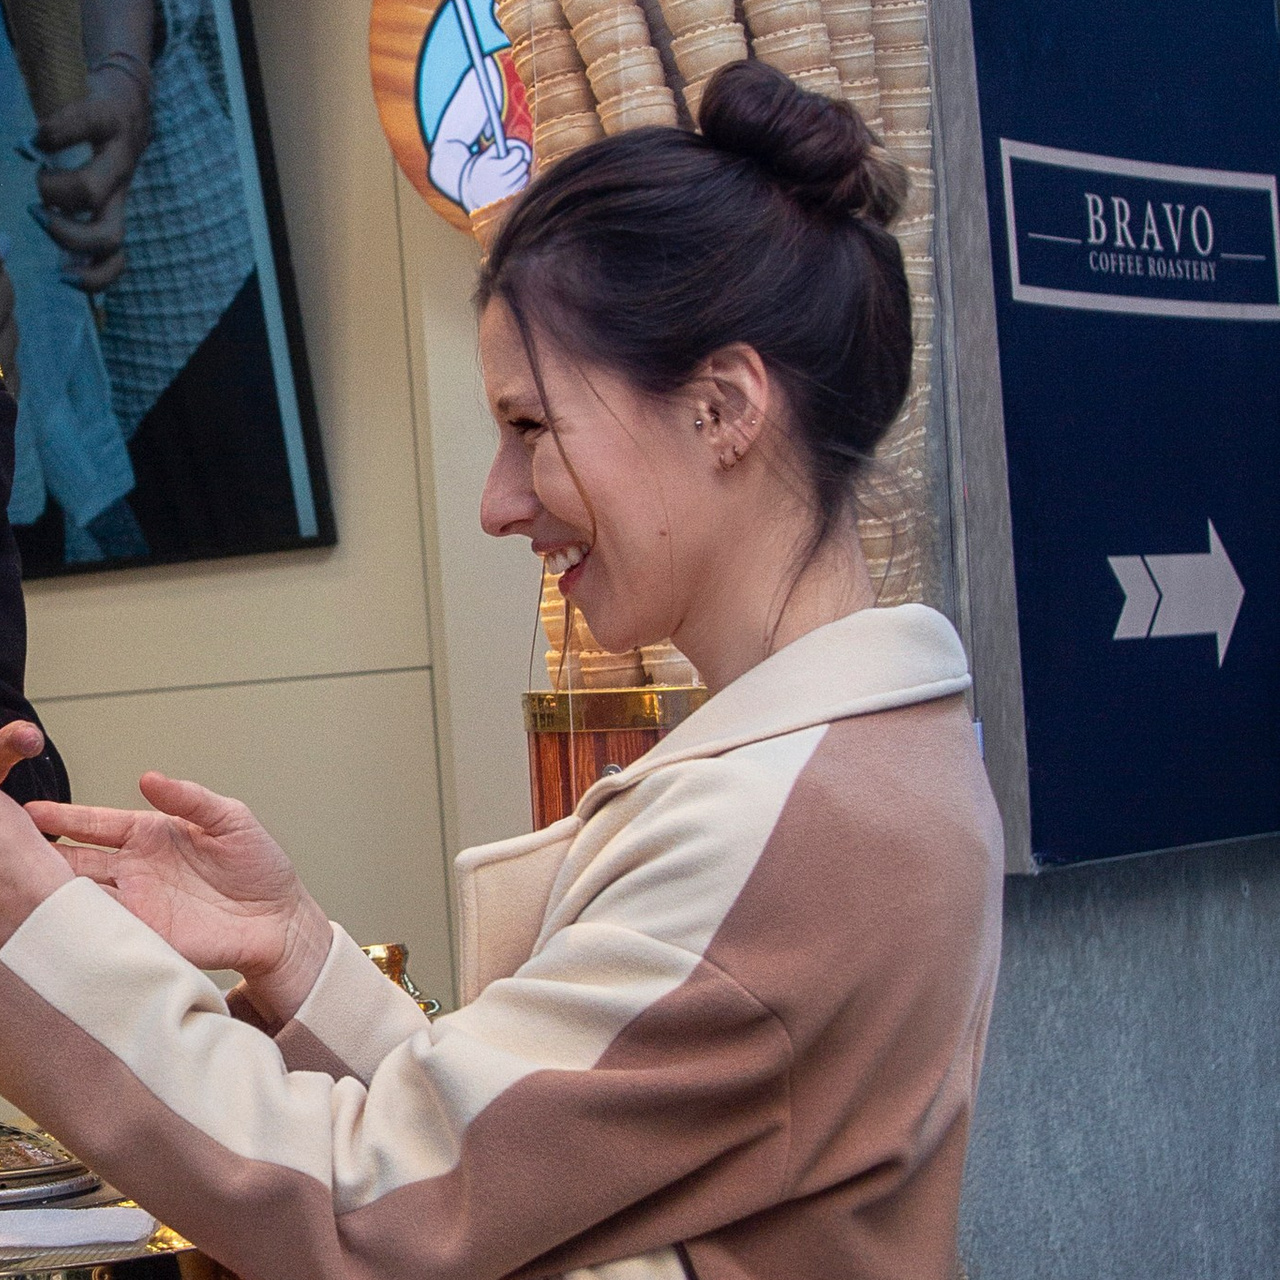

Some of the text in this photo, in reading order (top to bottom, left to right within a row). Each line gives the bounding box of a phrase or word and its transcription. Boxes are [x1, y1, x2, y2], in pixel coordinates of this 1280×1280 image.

[1084, 192, 1214, 257] BRAVO
[1089, 250, 1217, 282] COFFEE ROASTERY
